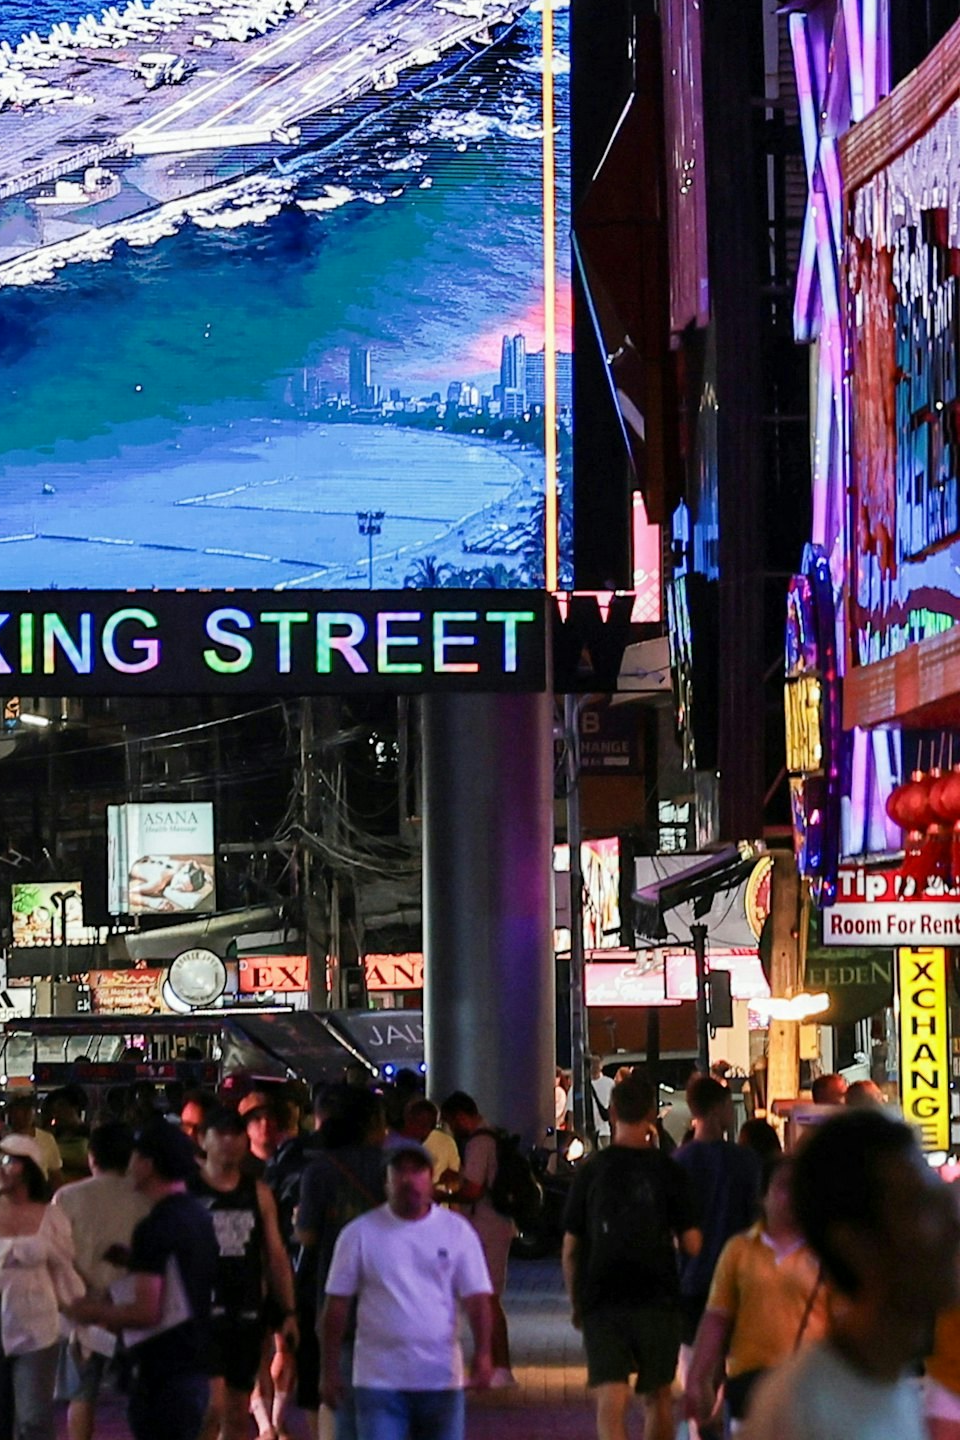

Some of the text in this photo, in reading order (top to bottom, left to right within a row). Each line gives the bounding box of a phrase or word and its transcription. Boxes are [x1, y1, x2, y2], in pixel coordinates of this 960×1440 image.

[203, 607, 536, 674] STREET
[144, 810, 199, 825] ASANA
[838, 869, 887, 903] Tip
[831, 914, 881, 935] Room
[888, 914, 915, 935] For
[369, 1023, 424, 1046] JAL
